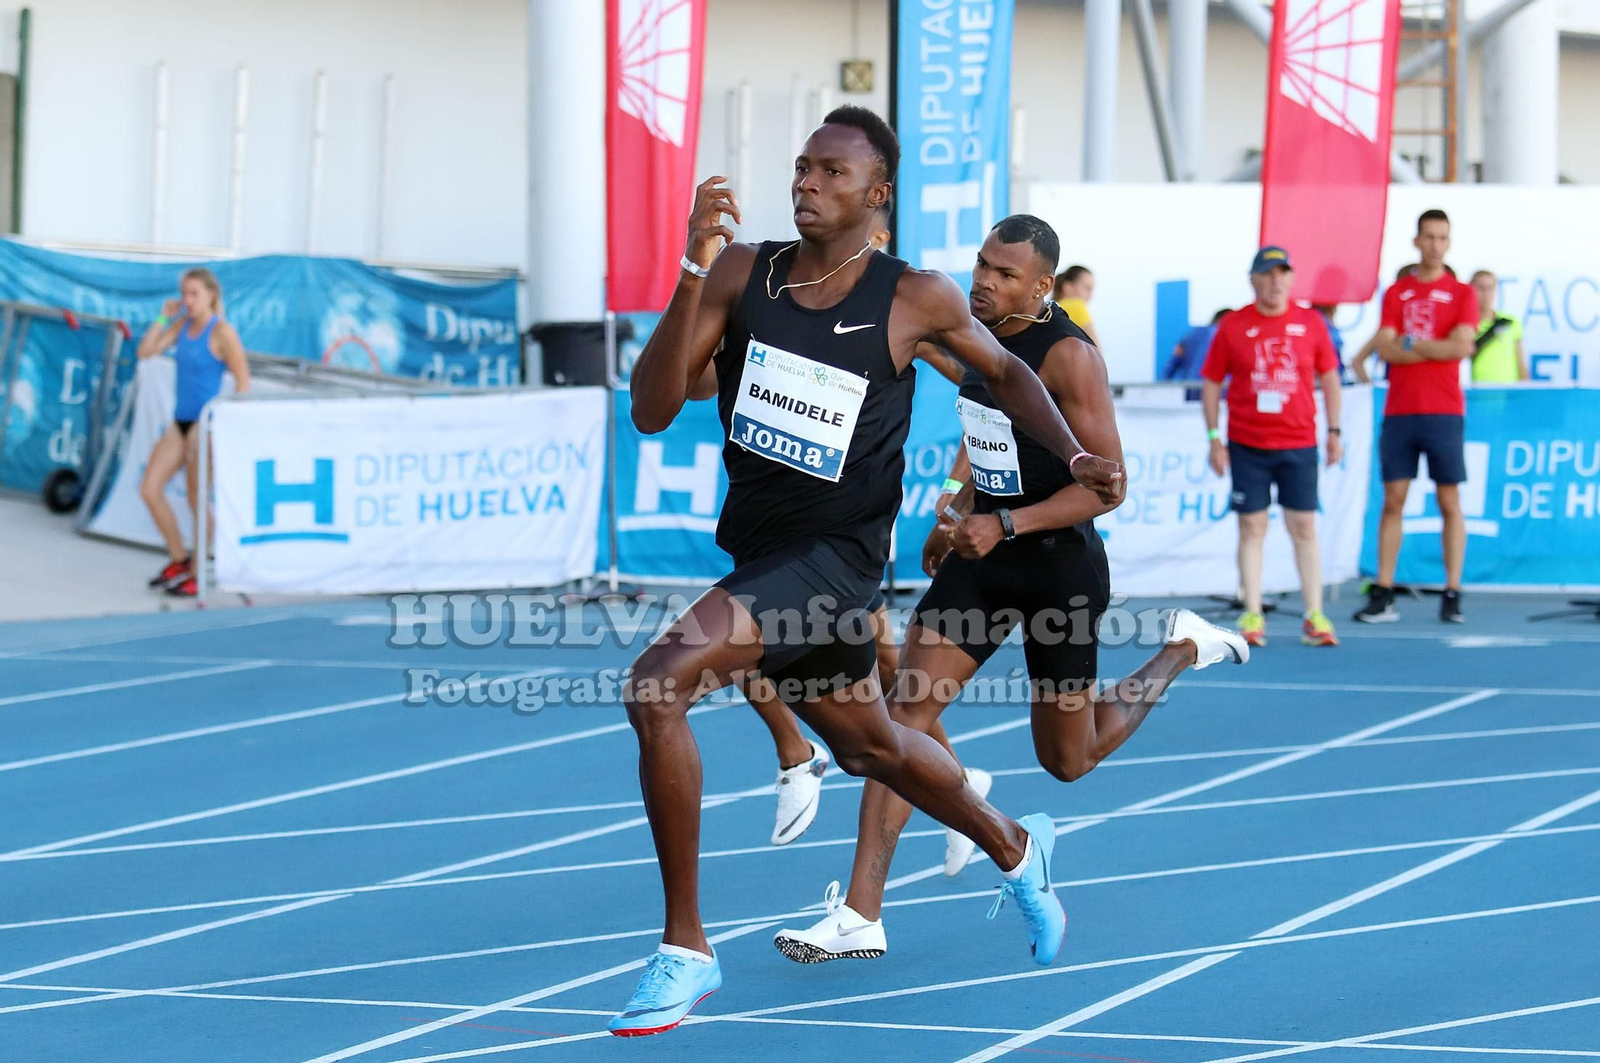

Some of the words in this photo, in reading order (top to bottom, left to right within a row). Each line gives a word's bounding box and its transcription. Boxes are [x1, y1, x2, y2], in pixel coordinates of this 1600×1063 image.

[766, 360, 777, 368] DE
[777, 363, 806, 378] HUELVA
[768, 352, 813, 372] DIPUTACIÓN
[748, 382, 845, 427] BAMIDELE
[354, 442, 588, 488] DIPUTACIÓN
[354, 493, 402, 528] DE
[418, 483, 567, 523] HUELVA
[1501, 482, 1555, 519] DE
[1565, 482, 1600, 519] H
